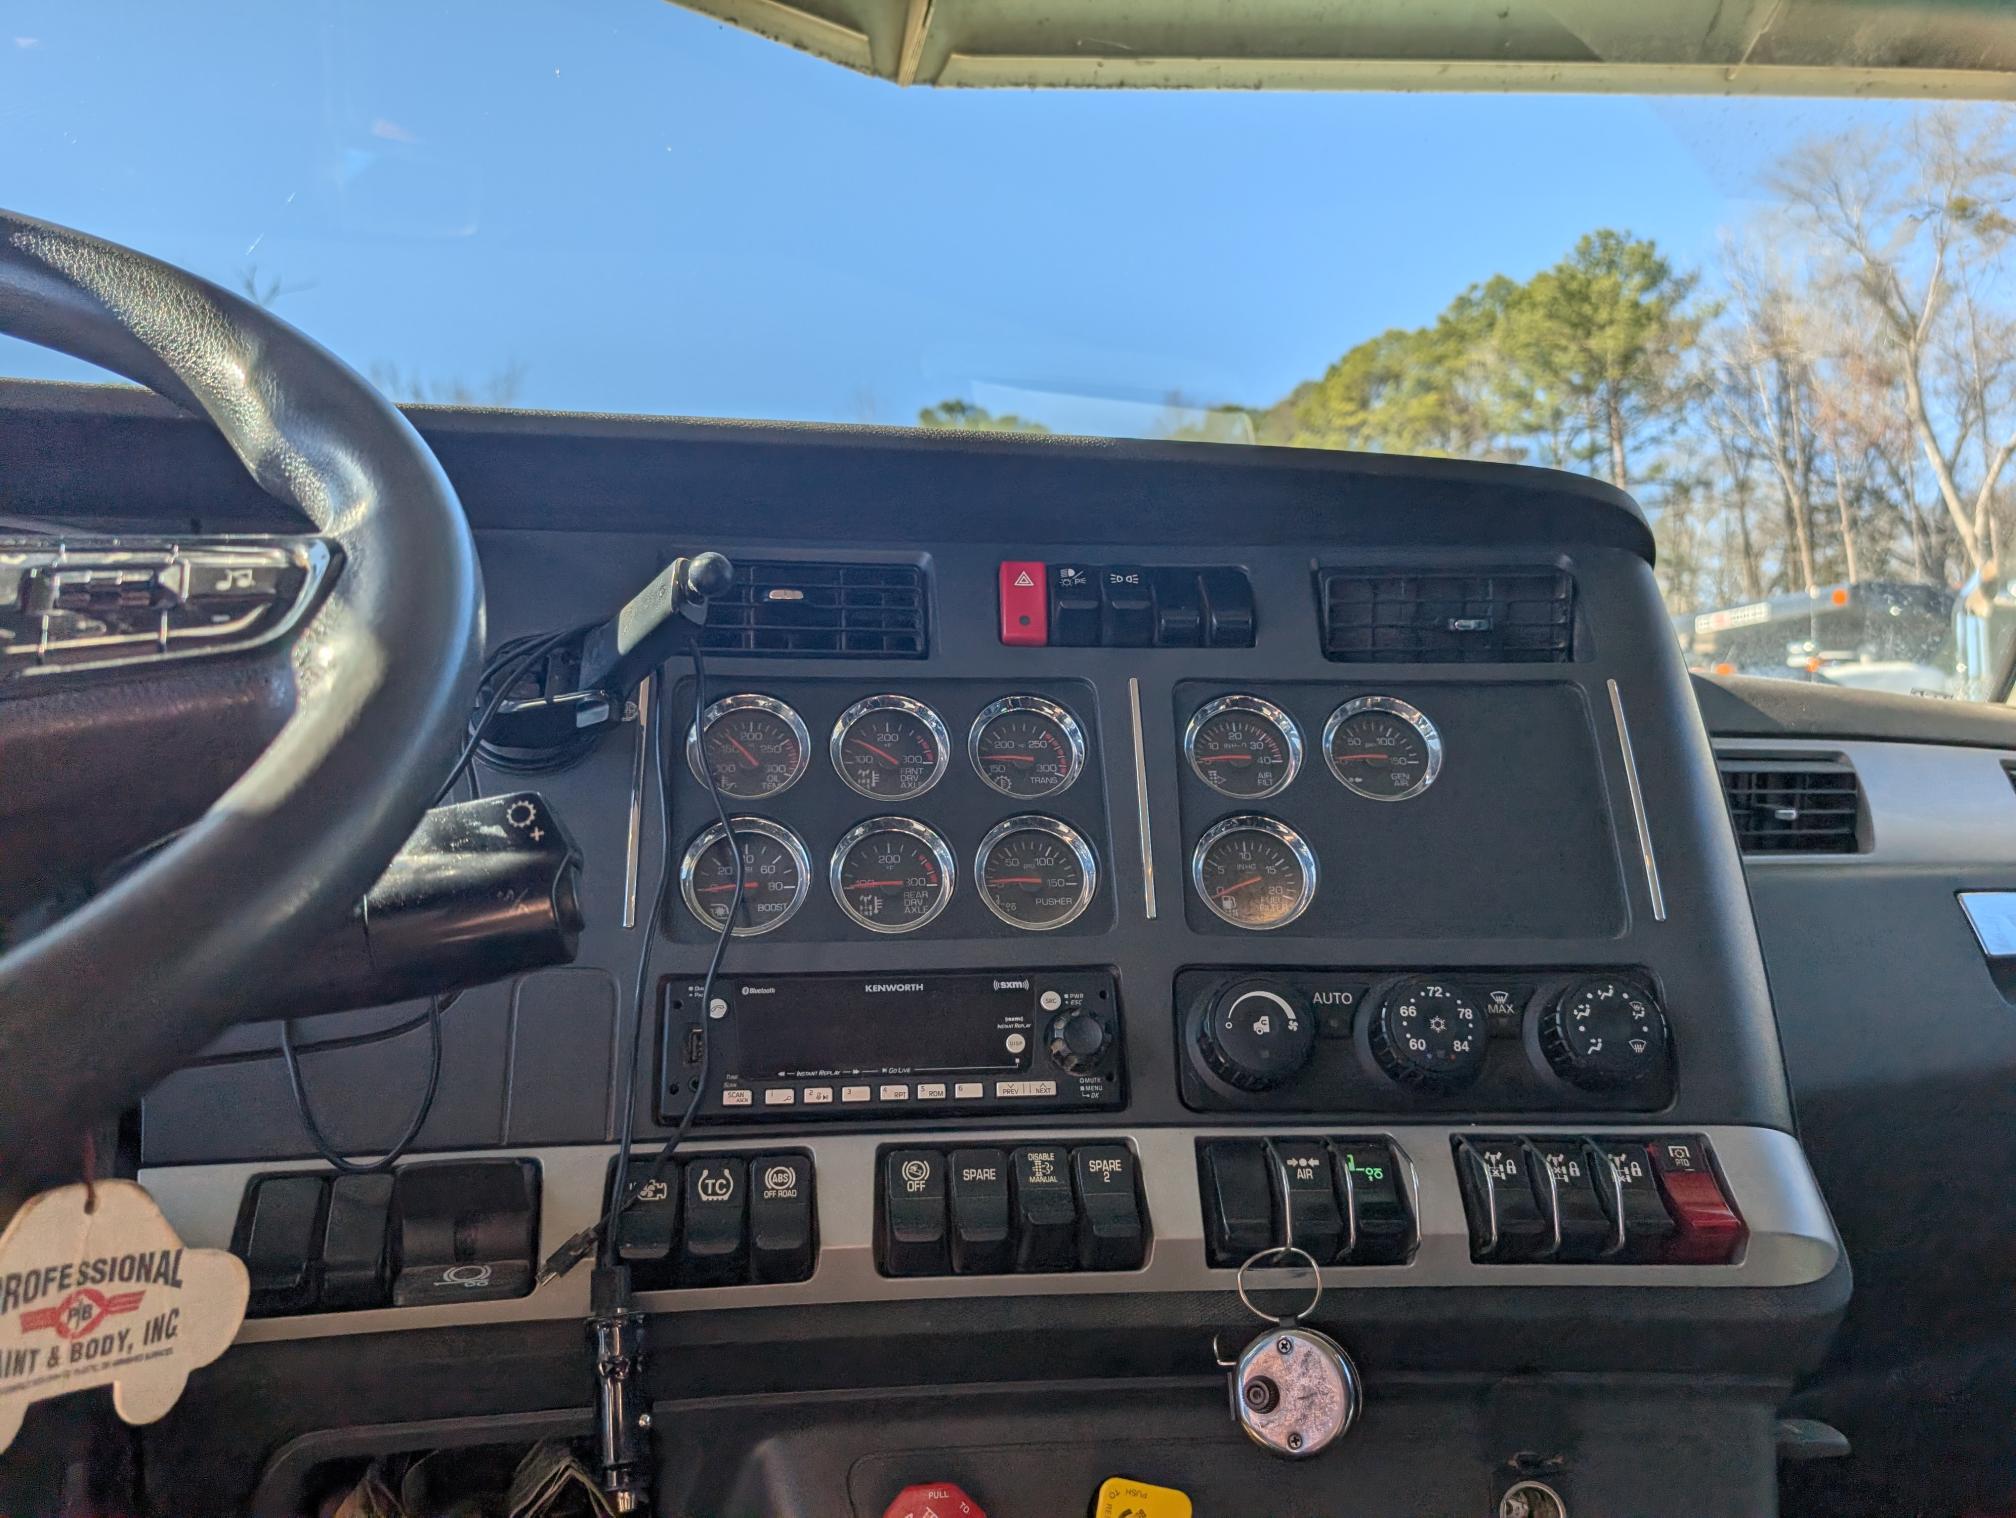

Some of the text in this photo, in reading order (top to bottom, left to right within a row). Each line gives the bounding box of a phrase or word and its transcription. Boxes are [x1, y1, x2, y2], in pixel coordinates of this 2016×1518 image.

[741, 732, 763, 740] 200
[877, 733, 899, 742] 200
[1228, 731, 1242, 740] 20
[994, 741, 1015, 749] 200
[1028, 740, 1048, 749] 250
[1208, 742, 1219, 750] 10
[1249, 741, 1264, 750] 30
[1347, 737, 1361, 746] 50
[1376, 737, 1395, 746] 100
[760, 745, 782, 753] 250
[903, 755, 923, 764] 300
[1257, 756, 1272, 765] 40
[1036, 764, 1057, 773] 300
[766, 775, 778, 783] OIL
[1030, 776, 1058, 784] TRANS
[878, 854, 901, 864] 200
[1240, 852, 1252, 860] 10
[1004, 858, 1020, 867] 50
[1034, 857, 1054, 866] 100
[718, 866, 733, 876] 20
[760, 865, 776, 875] 60
[1217, 866, 1225, 875] 5
[1265, 865, 1277, 875] 15
[768, 881, 784, 891] 80
[907, 877, 927, 887] 300
[1047, 879, 1066, 888] 150
[903, 891, 929, 899] REAR
[1268, 886, 1283, 895] 20
[903, 899, 924, 907] DRV
[1035, 897, 1073, 906] PUSHER
[757, 903, 787, 912] BOOST
[865, 983, 924, 992] KENWORTH
[1426, 986, 1443, 998] 72
[1313, 992, 1353, 1005] AUTO
[1400, 1006, 1417, 1017] 66
[1457, 1008, 1473, 1019] 78
[1487, 1004, 1514, 1014] MAX
[1409, 1038, 1426, 1050] 60
[1453, 1040, 1470, 1052] 84
[920, 1085, 926, 1093] 5
[1027, 1152, 1055, 1161] DISABLE
[1089, 1159, 1122, 1172] SPARE
[772, 1173, 789, 1184] ABS
[963, 1168, 996, 1181] SPARE
[1103, 1171, 1111, 1183] 2
[1296, 1168, 1313, 1180] AIR
[1029, 1175, 1058, 1184] MANUAL
[704, 1179, 727, 1194] TC
[906, 1181, 926, 1192] OFF
[763, 1189, 797, 1198] OFF ROAD
[47, 1345, 60, 1369] &
[69, 1328, 134, 1364] BODY,
[928, 1490, 949, 1500] PULL
[1108, 1487, 1120, 1500] TO
[1126, 1487, 1148, 1500] PUSH
[960, 1501, 970, 1514] TO
